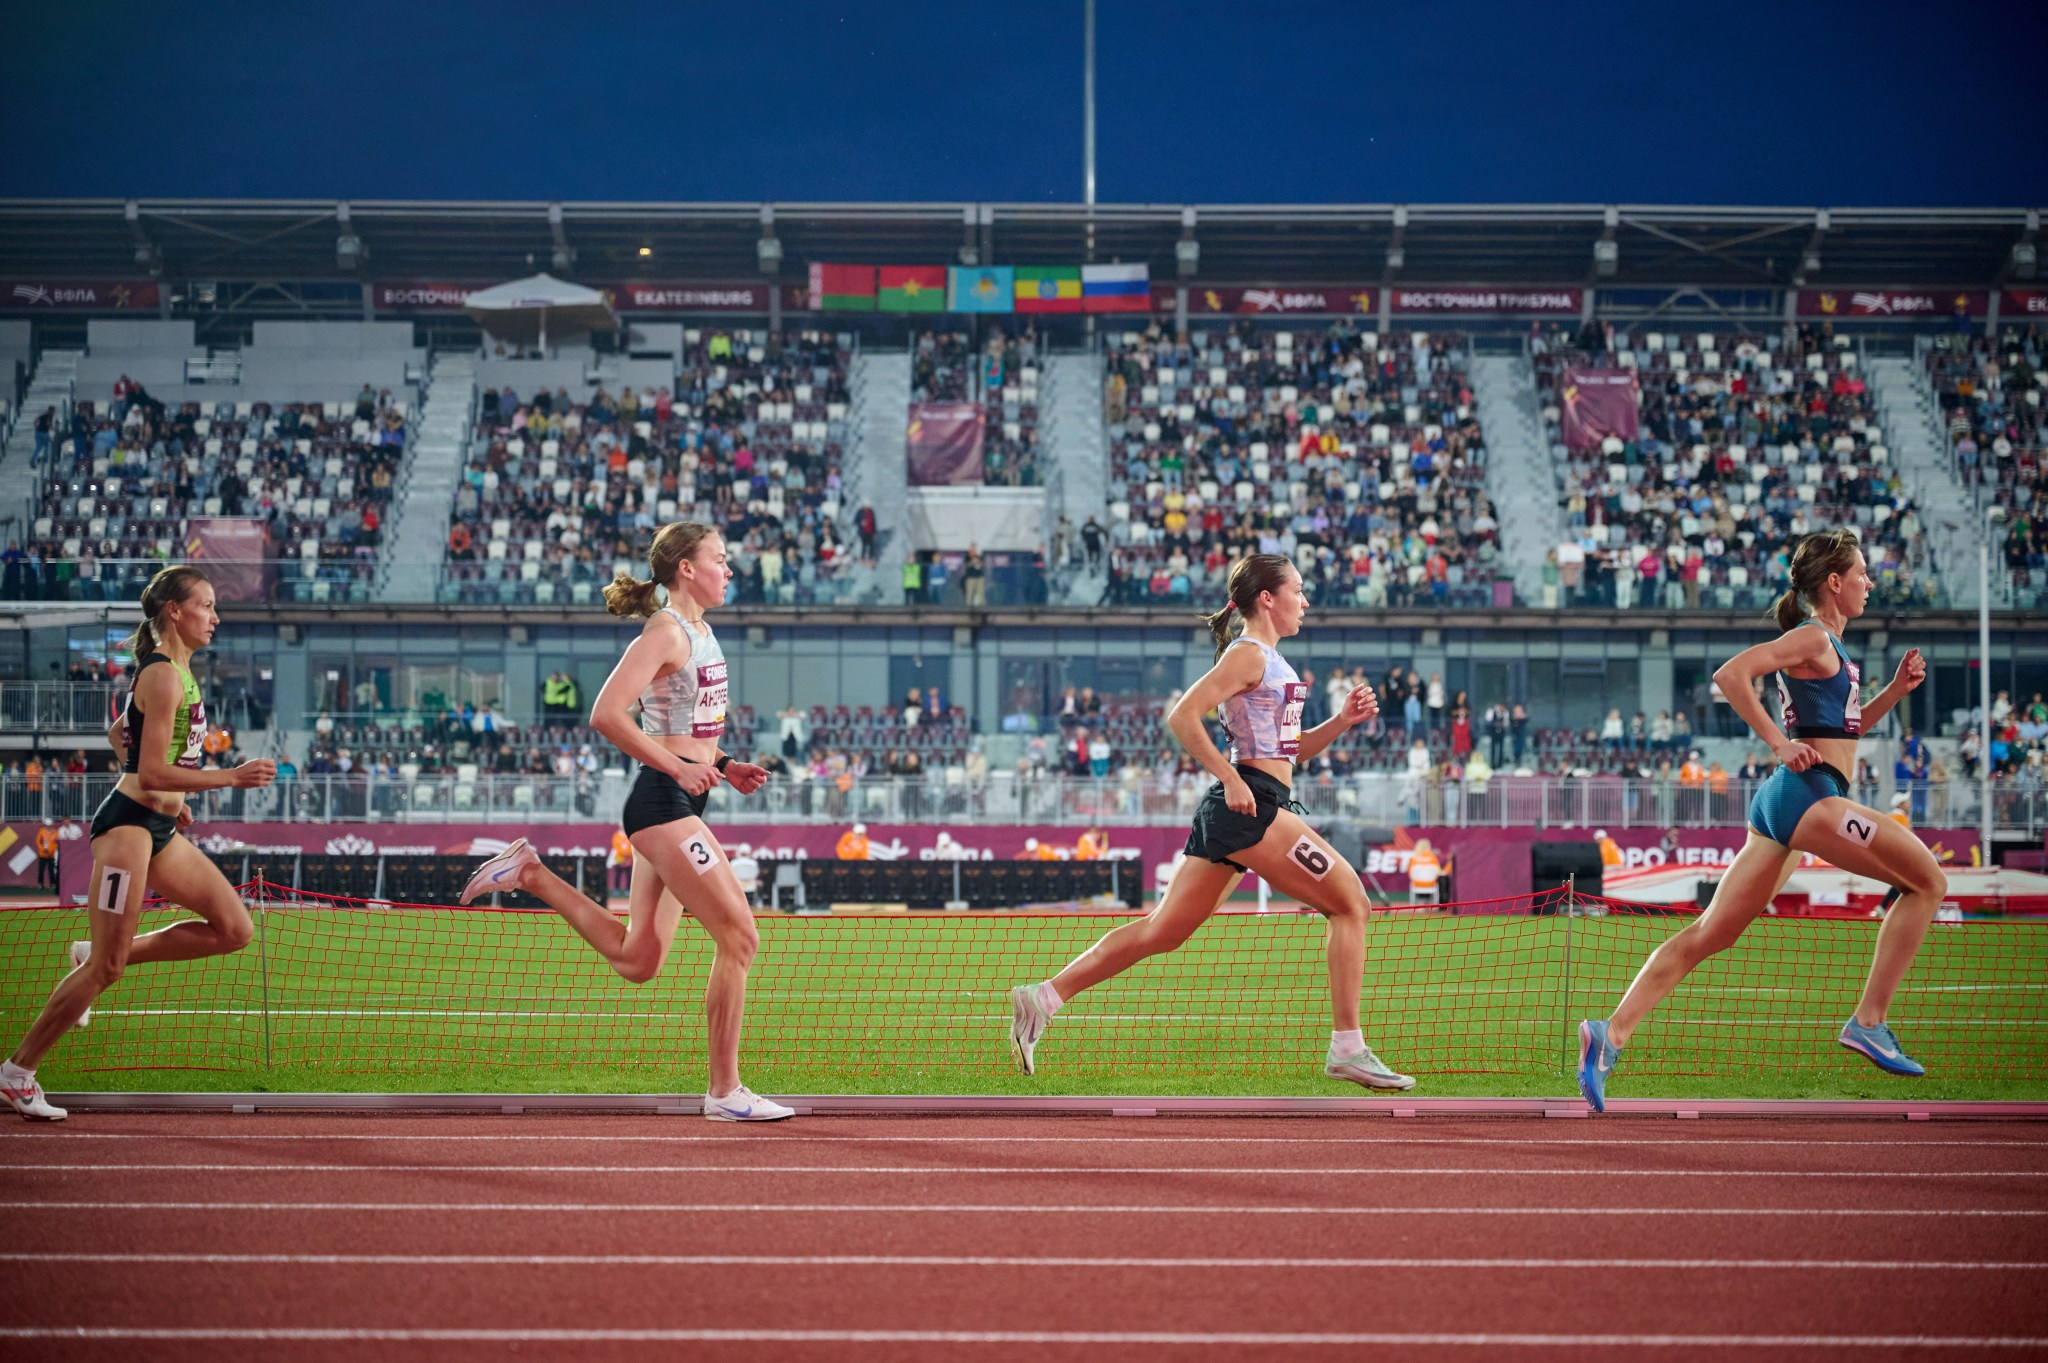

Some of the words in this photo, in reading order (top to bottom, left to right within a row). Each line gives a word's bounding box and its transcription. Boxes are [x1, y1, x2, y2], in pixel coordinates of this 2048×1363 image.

[384, 289, 474, 304] ВОСТОЧНА
[634, 290, 753, 305] EKATERINBURG
[1401, 292, 1497, 308] ВОСТОЧНАЯ
[1500, 293, 1572, 308] ТРИБУНА
[2027, 297, 2048, 312] EK
[706, 664, 728, 681] FONBE
[1847, 819, 1870, 841] 2
[689, 842, 710, 865] 3
[1294, 842, 1329, 875] 6
[1365, 850, 1414, 873] BET
[106, 872, 121, 910] 1
